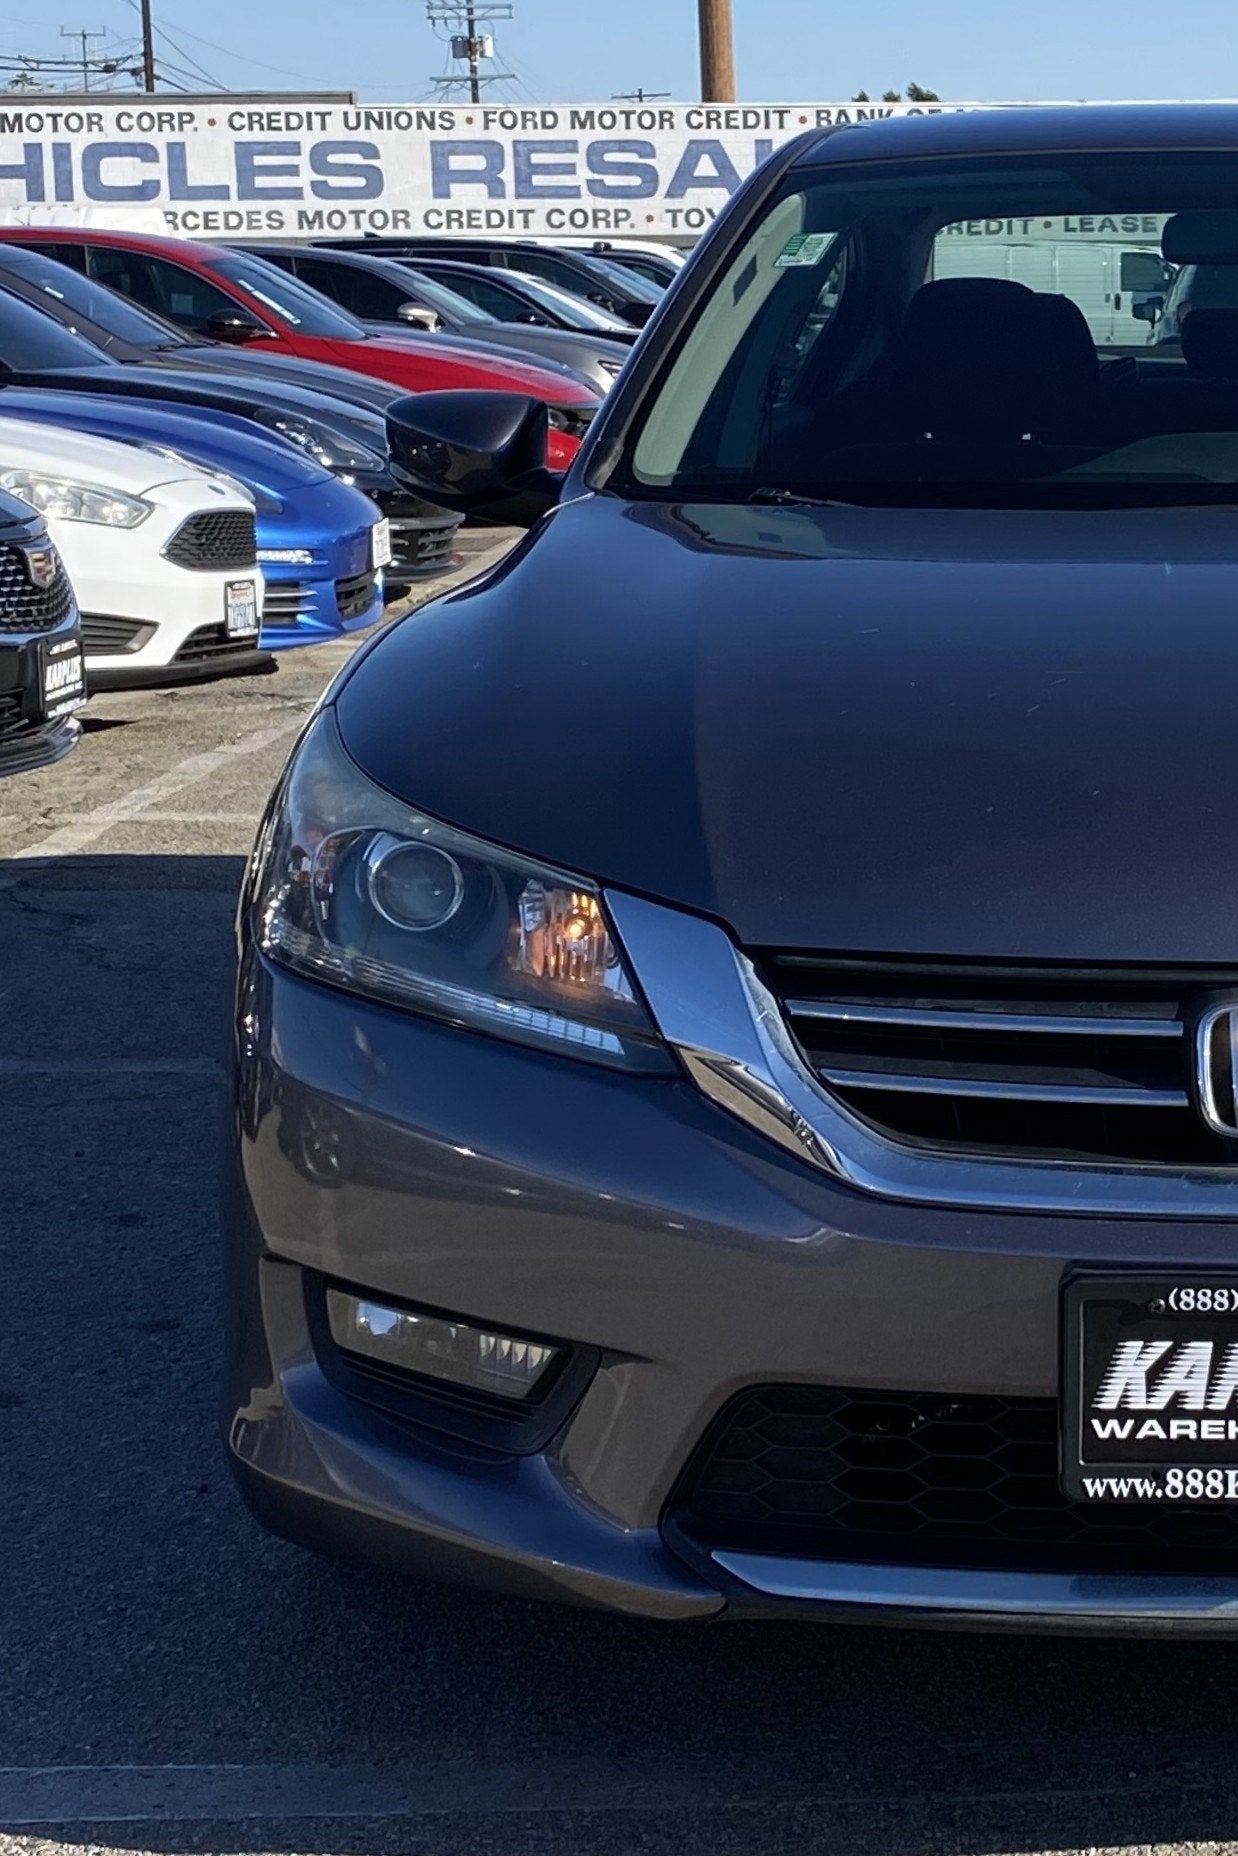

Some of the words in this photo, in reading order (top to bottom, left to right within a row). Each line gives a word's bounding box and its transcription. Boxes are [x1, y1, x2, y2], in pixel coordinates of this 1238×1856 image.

[0, 112, 104, 133] MOTOR
[115, 111, 198, 132] CORP.
[227, 110, 333, 132] CREDIT
[343, 110, 456, 132] UNIONS
[483, 110, 559, 131] FORD
[570, 109, 676, 131] MOTOR
[685, 109, 791, 130] CREDIT
[430, 138, 774, 200] RESA
[298, 208, 412, 230] MOTOR
[423, 208, 536, 230] CREDIT
[545, 207, 636, 229] CORP.
[937, 218, 1035, 236] REDIT
[1063, 216, 1158, 233] LEASE
